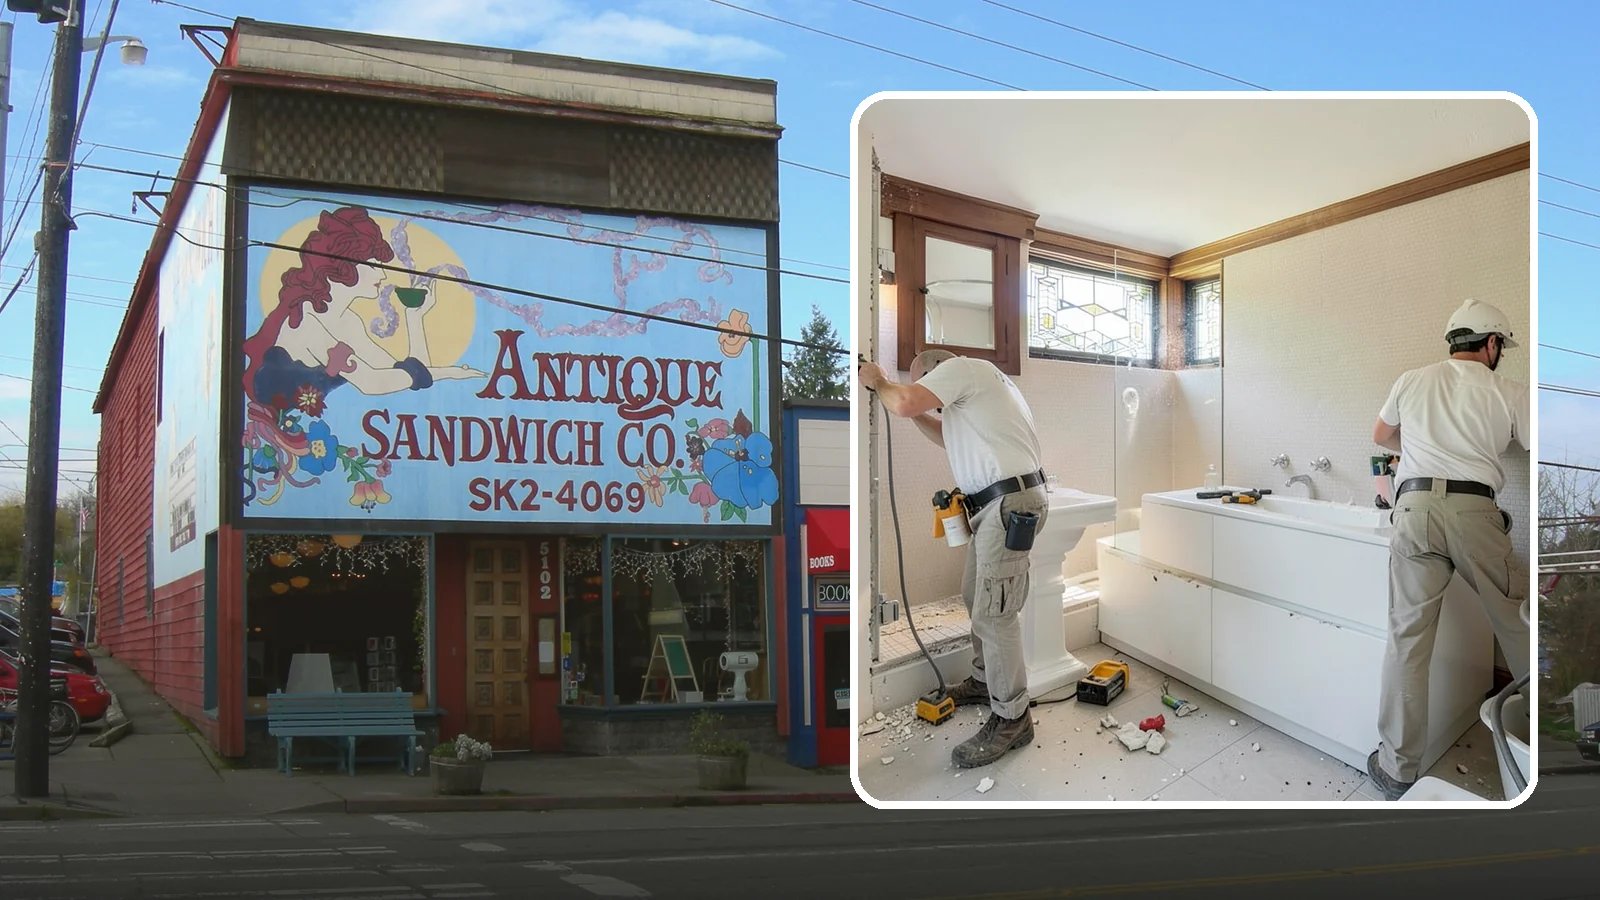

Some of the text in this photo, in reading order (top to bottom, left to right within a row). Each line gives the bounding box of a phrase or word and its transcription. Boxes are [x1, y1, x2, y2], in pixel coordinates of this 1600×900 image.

[475, 329, 723, 421] ANTIQUE
[361, 408, 685, 468] SANDWICH CO.
[468, 477, 646, 512] SK2-4069
[539, 541, 551, 600] 5102
[809, 555, 835, 569] BOOKS
